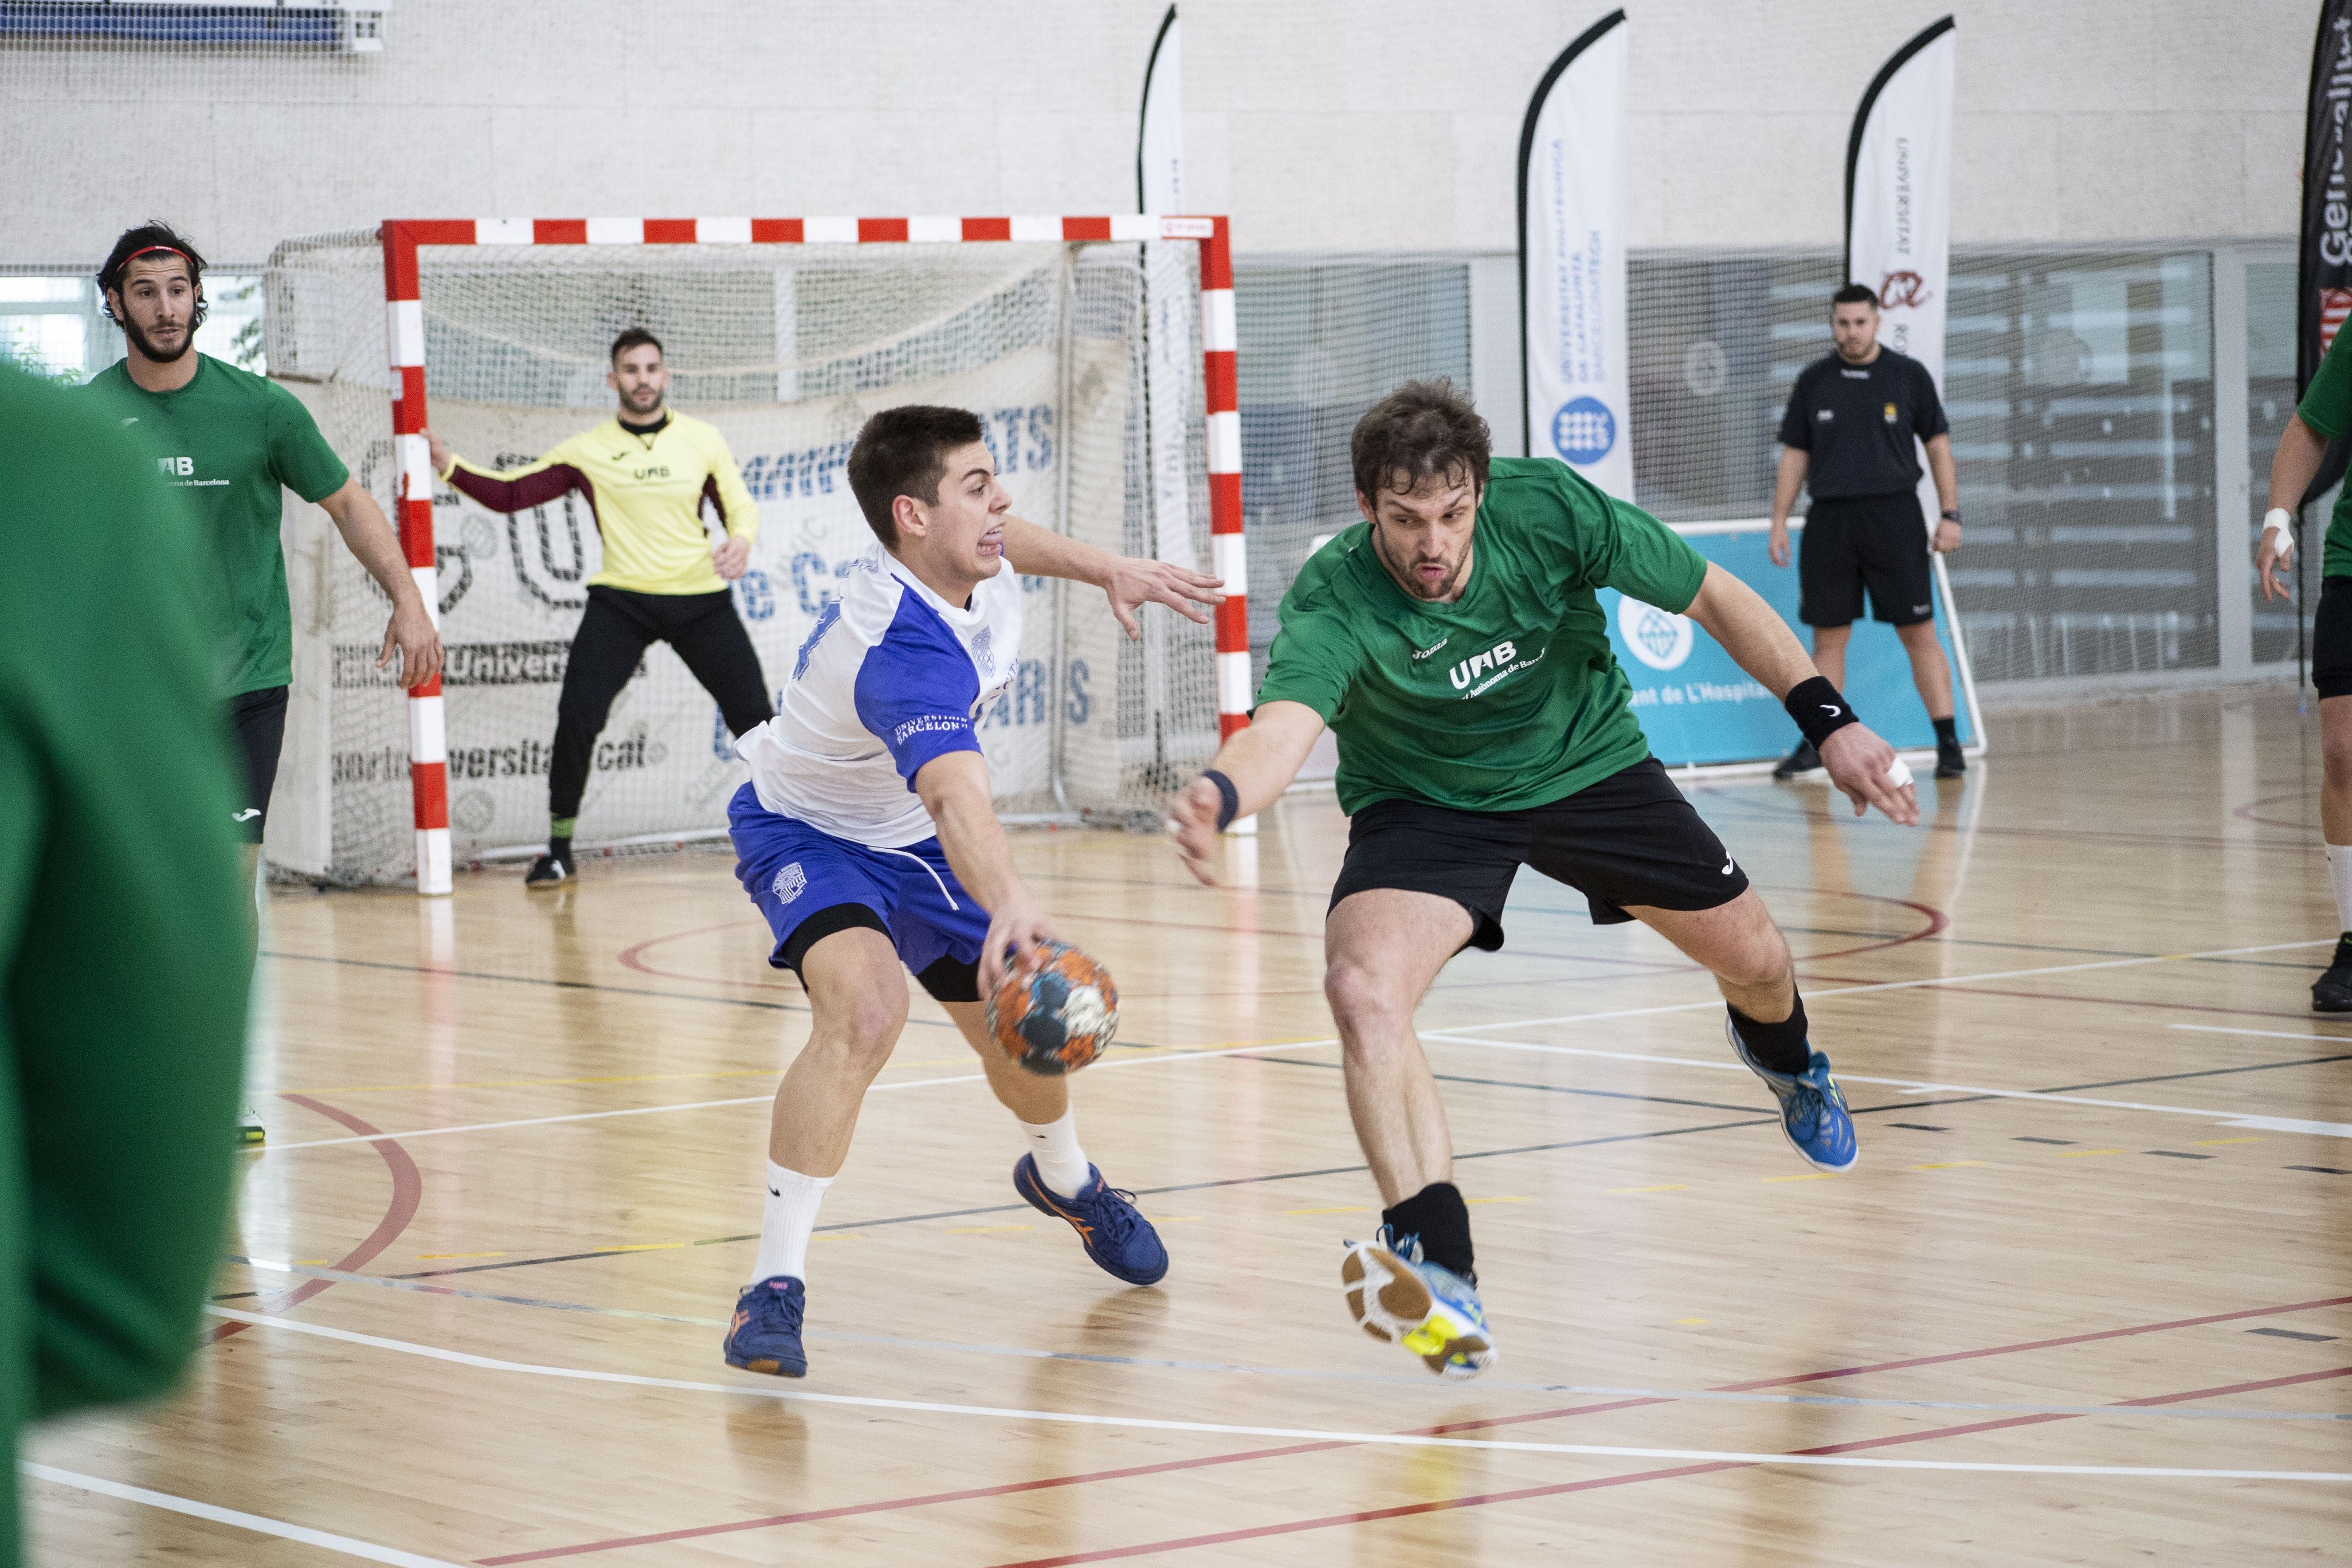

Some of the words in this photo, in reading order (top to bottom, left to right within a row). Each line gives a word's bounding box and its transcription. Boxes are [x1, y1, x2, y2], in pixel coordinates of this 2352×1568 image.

[158, 457, 194, 476] AB
[1412, 638, 1448, 660] Joma
[1449, 641, 1517, 689] UAB
[1508, 664, 1519, 673] de
[1661, 684, 1684, 705] de
